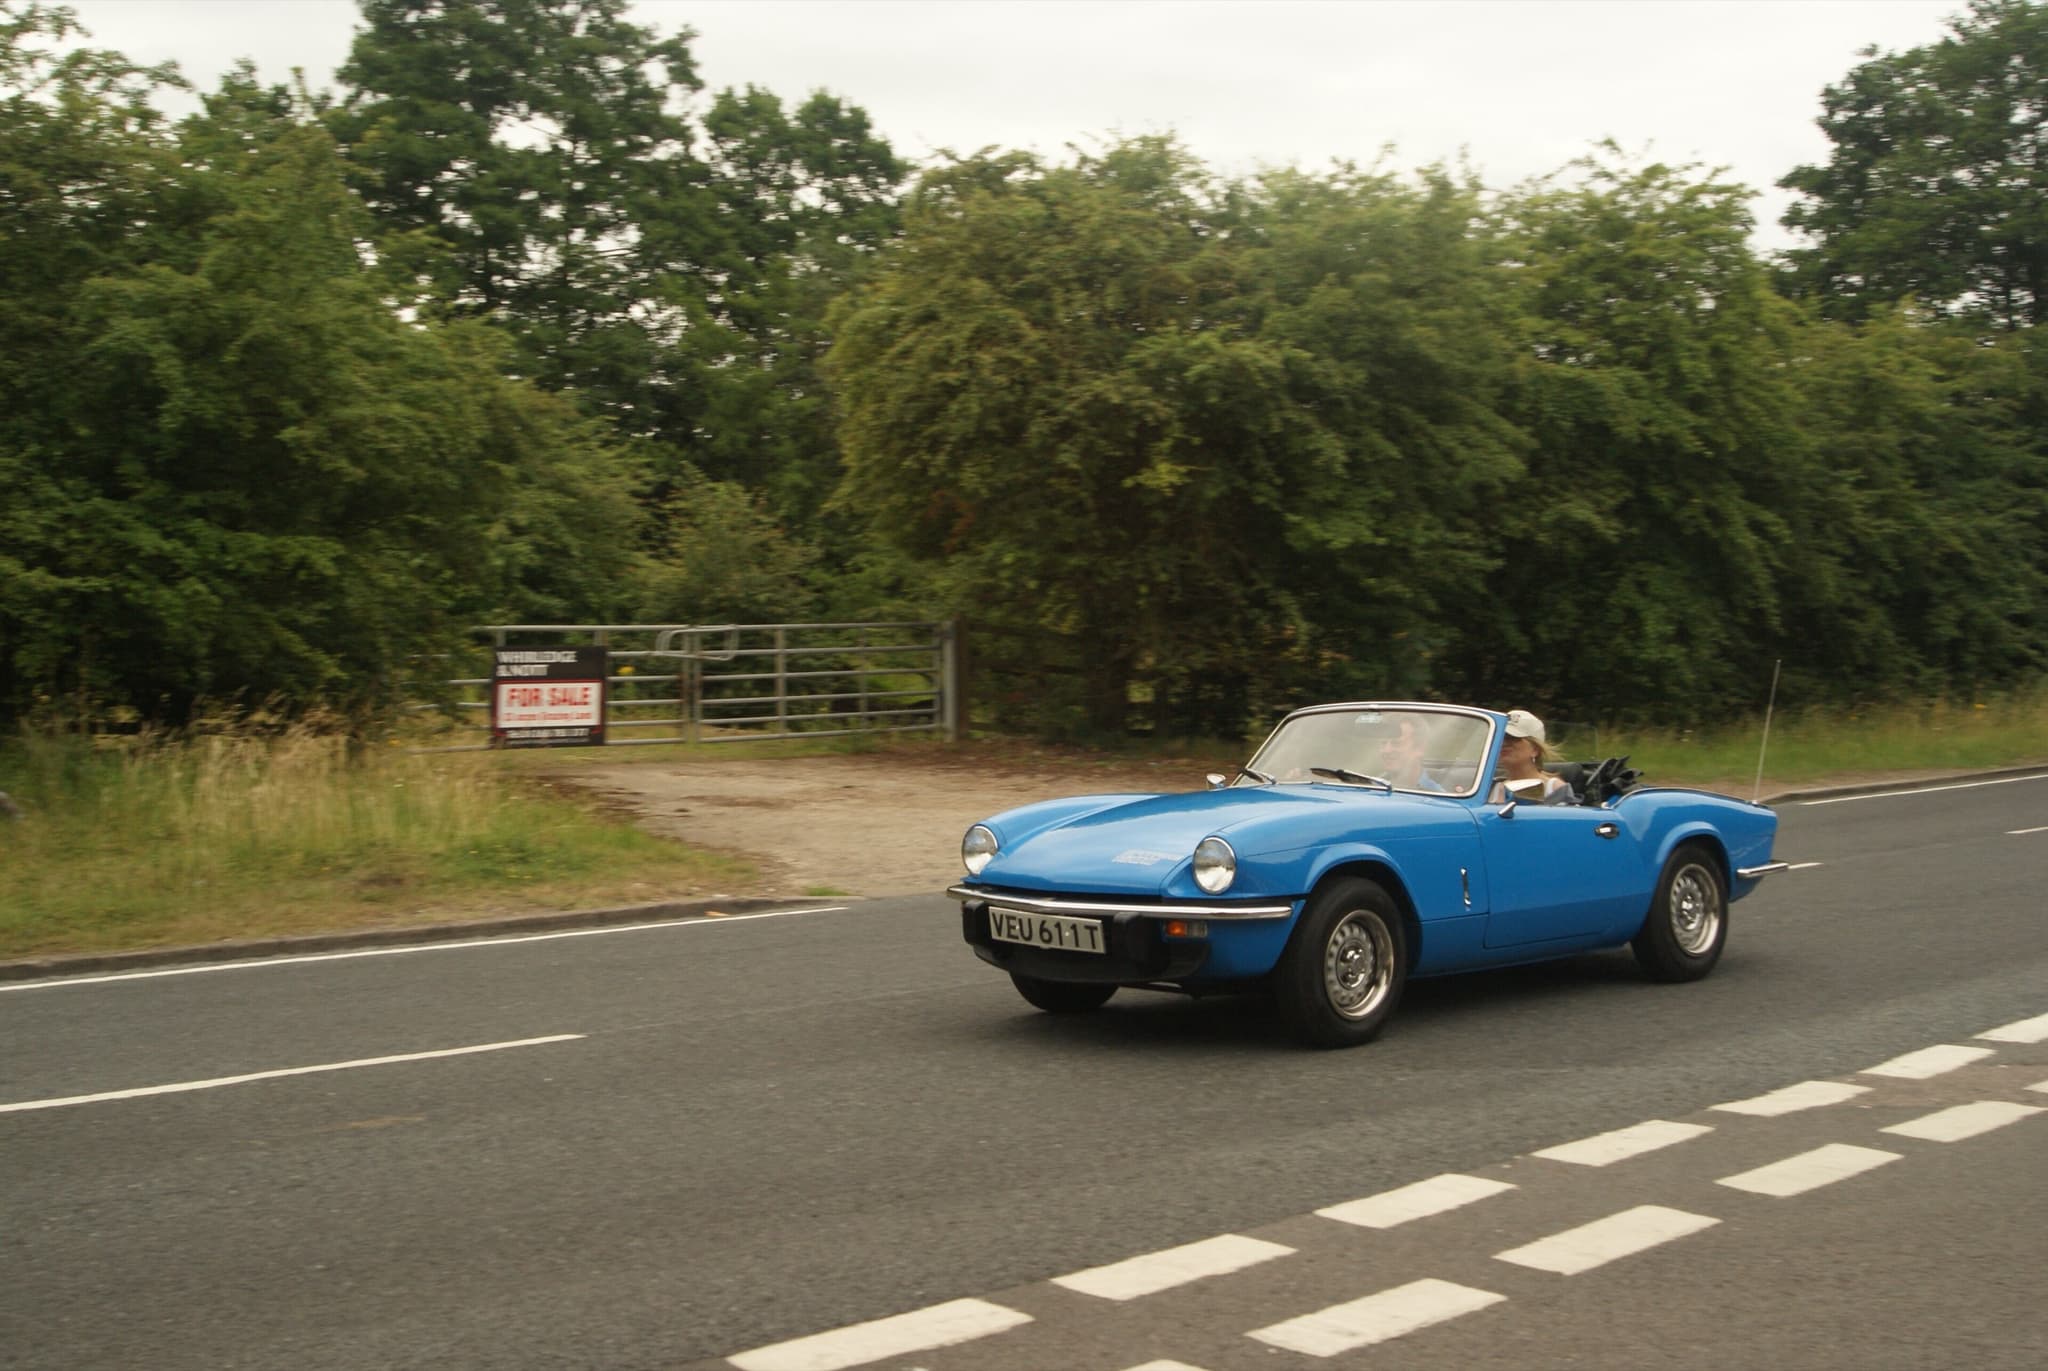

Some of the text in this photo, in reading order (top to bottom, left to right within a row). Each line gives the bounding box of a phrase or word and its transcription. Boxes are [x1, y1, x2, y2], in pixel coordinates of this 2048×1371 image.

[506, 686, 591, 707] FOR SALE
[991, 912, 1033, 941] VEU
